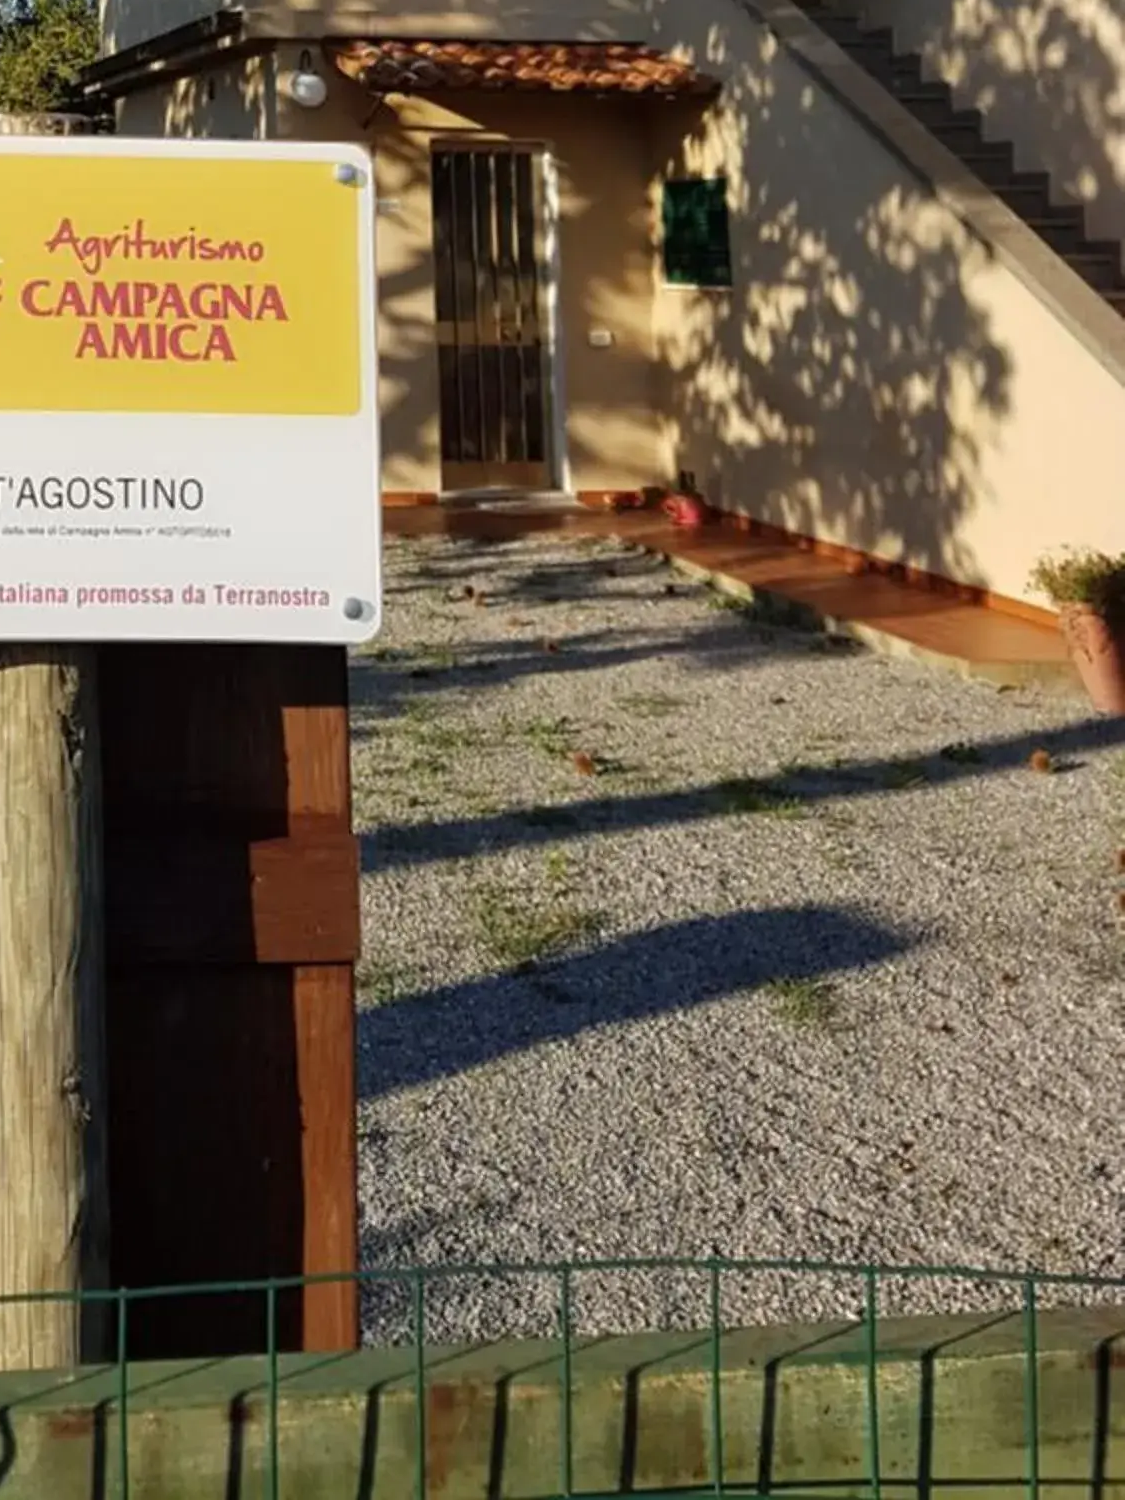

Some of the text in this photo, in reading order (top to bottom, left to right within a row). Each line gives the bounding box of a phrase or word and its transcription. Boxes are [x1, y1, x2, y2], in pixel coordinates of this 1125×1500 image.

[45, 218, 264, 275] Agriturismo
[21, 280, 288, 321] CAMPAGNA
[75, 322, 236, 362] AMICA
[76, 586, 174, 609] promossa
[181, 585, 206, 605] da
[213, 585, 331, 607] Terranostra
